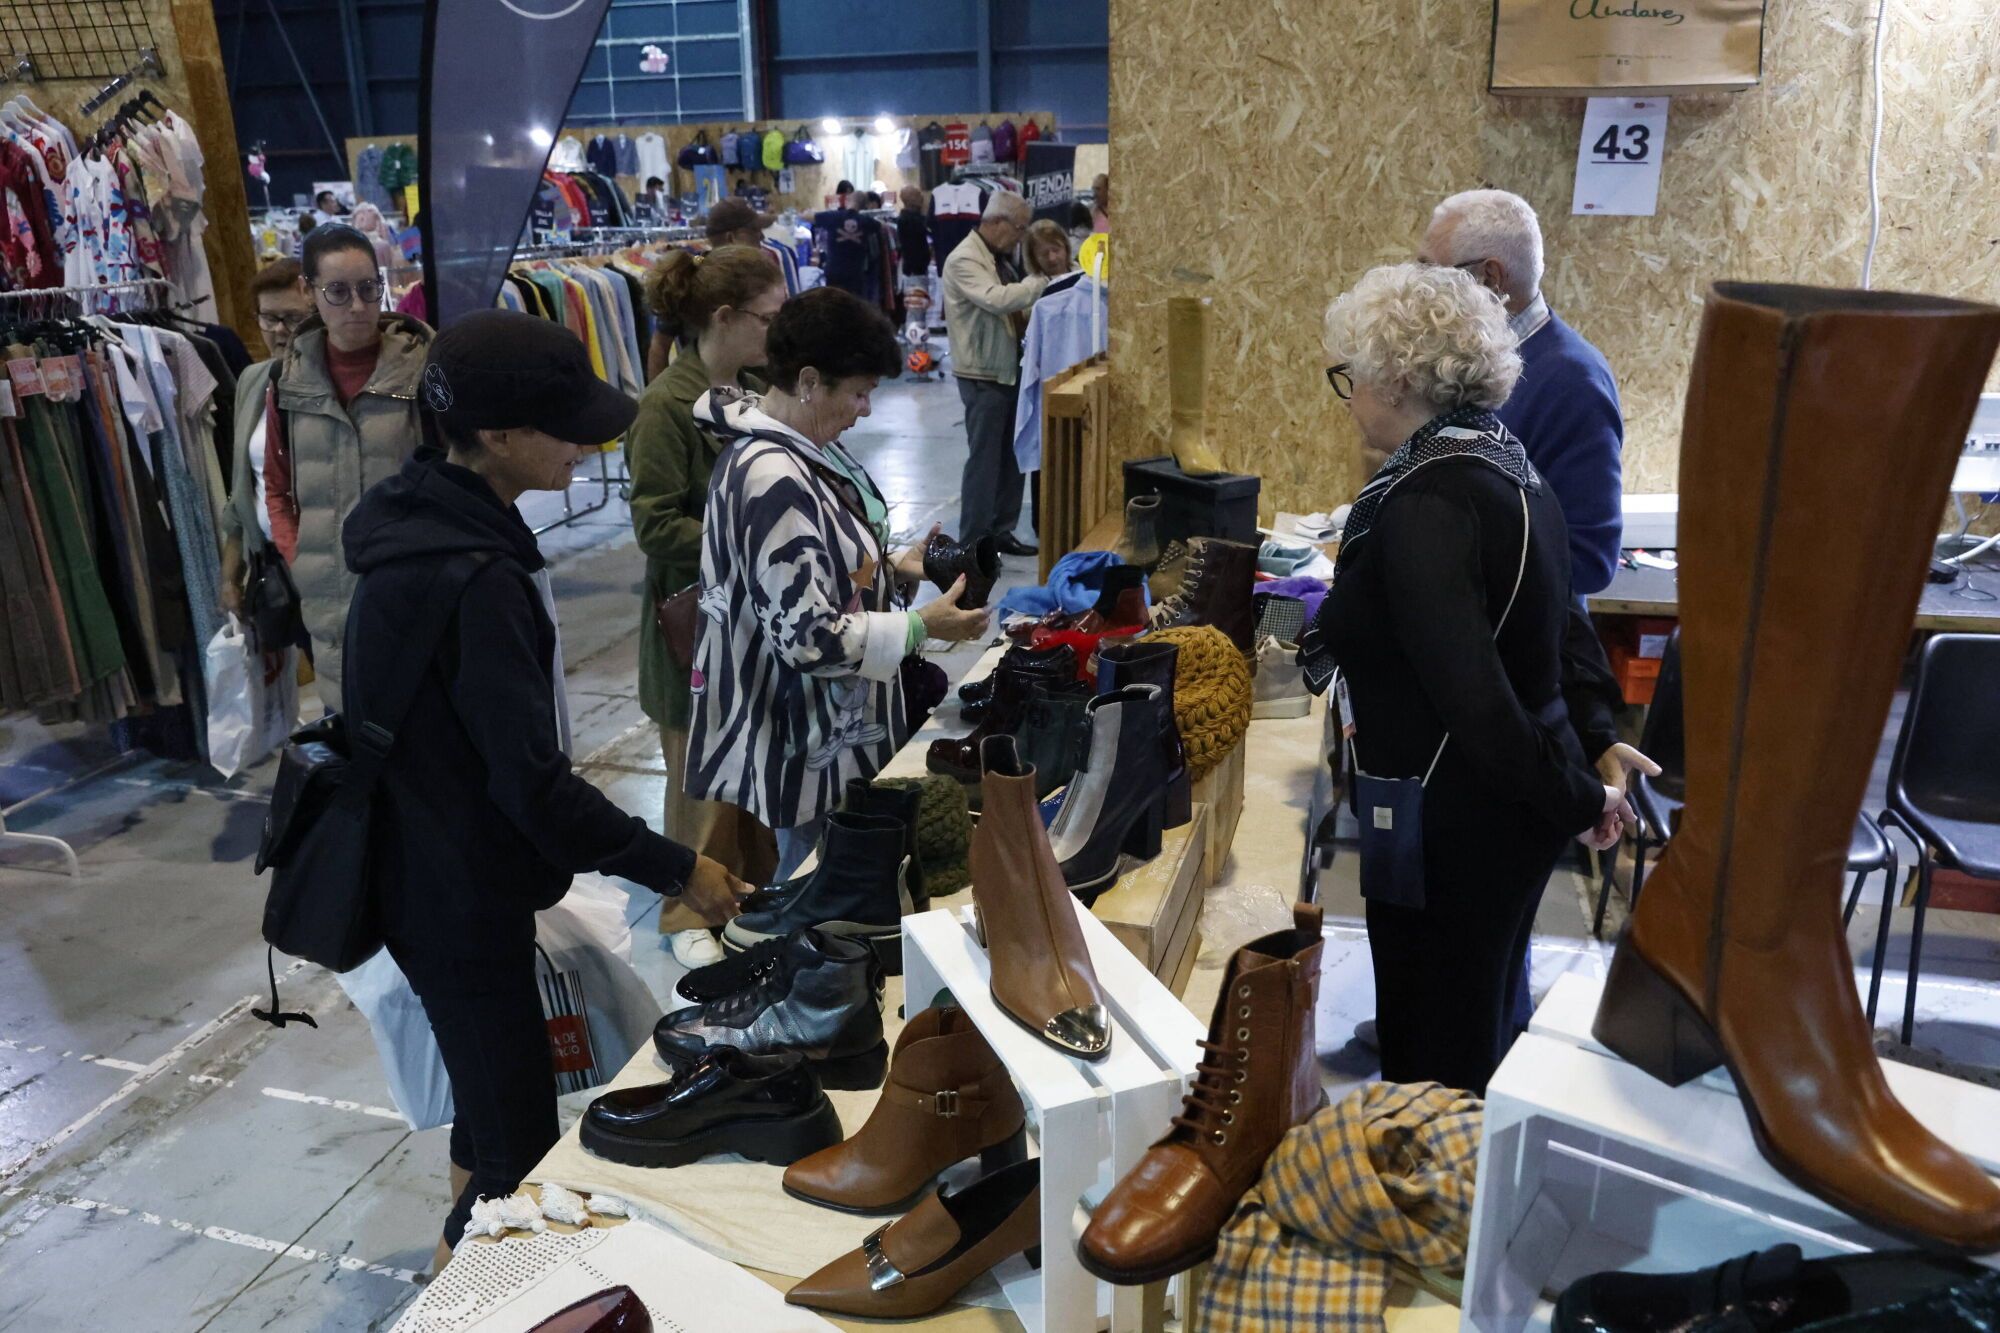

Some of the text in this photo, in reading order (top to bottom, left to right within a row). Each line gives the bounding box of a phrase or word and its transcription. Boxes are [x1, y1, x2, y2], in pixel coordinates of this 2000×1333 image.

[1592, 124, 1650, 160] 43
[1026, 172, 1072, 198] TIENDA
[562, 1032, 577, 1043] DE
